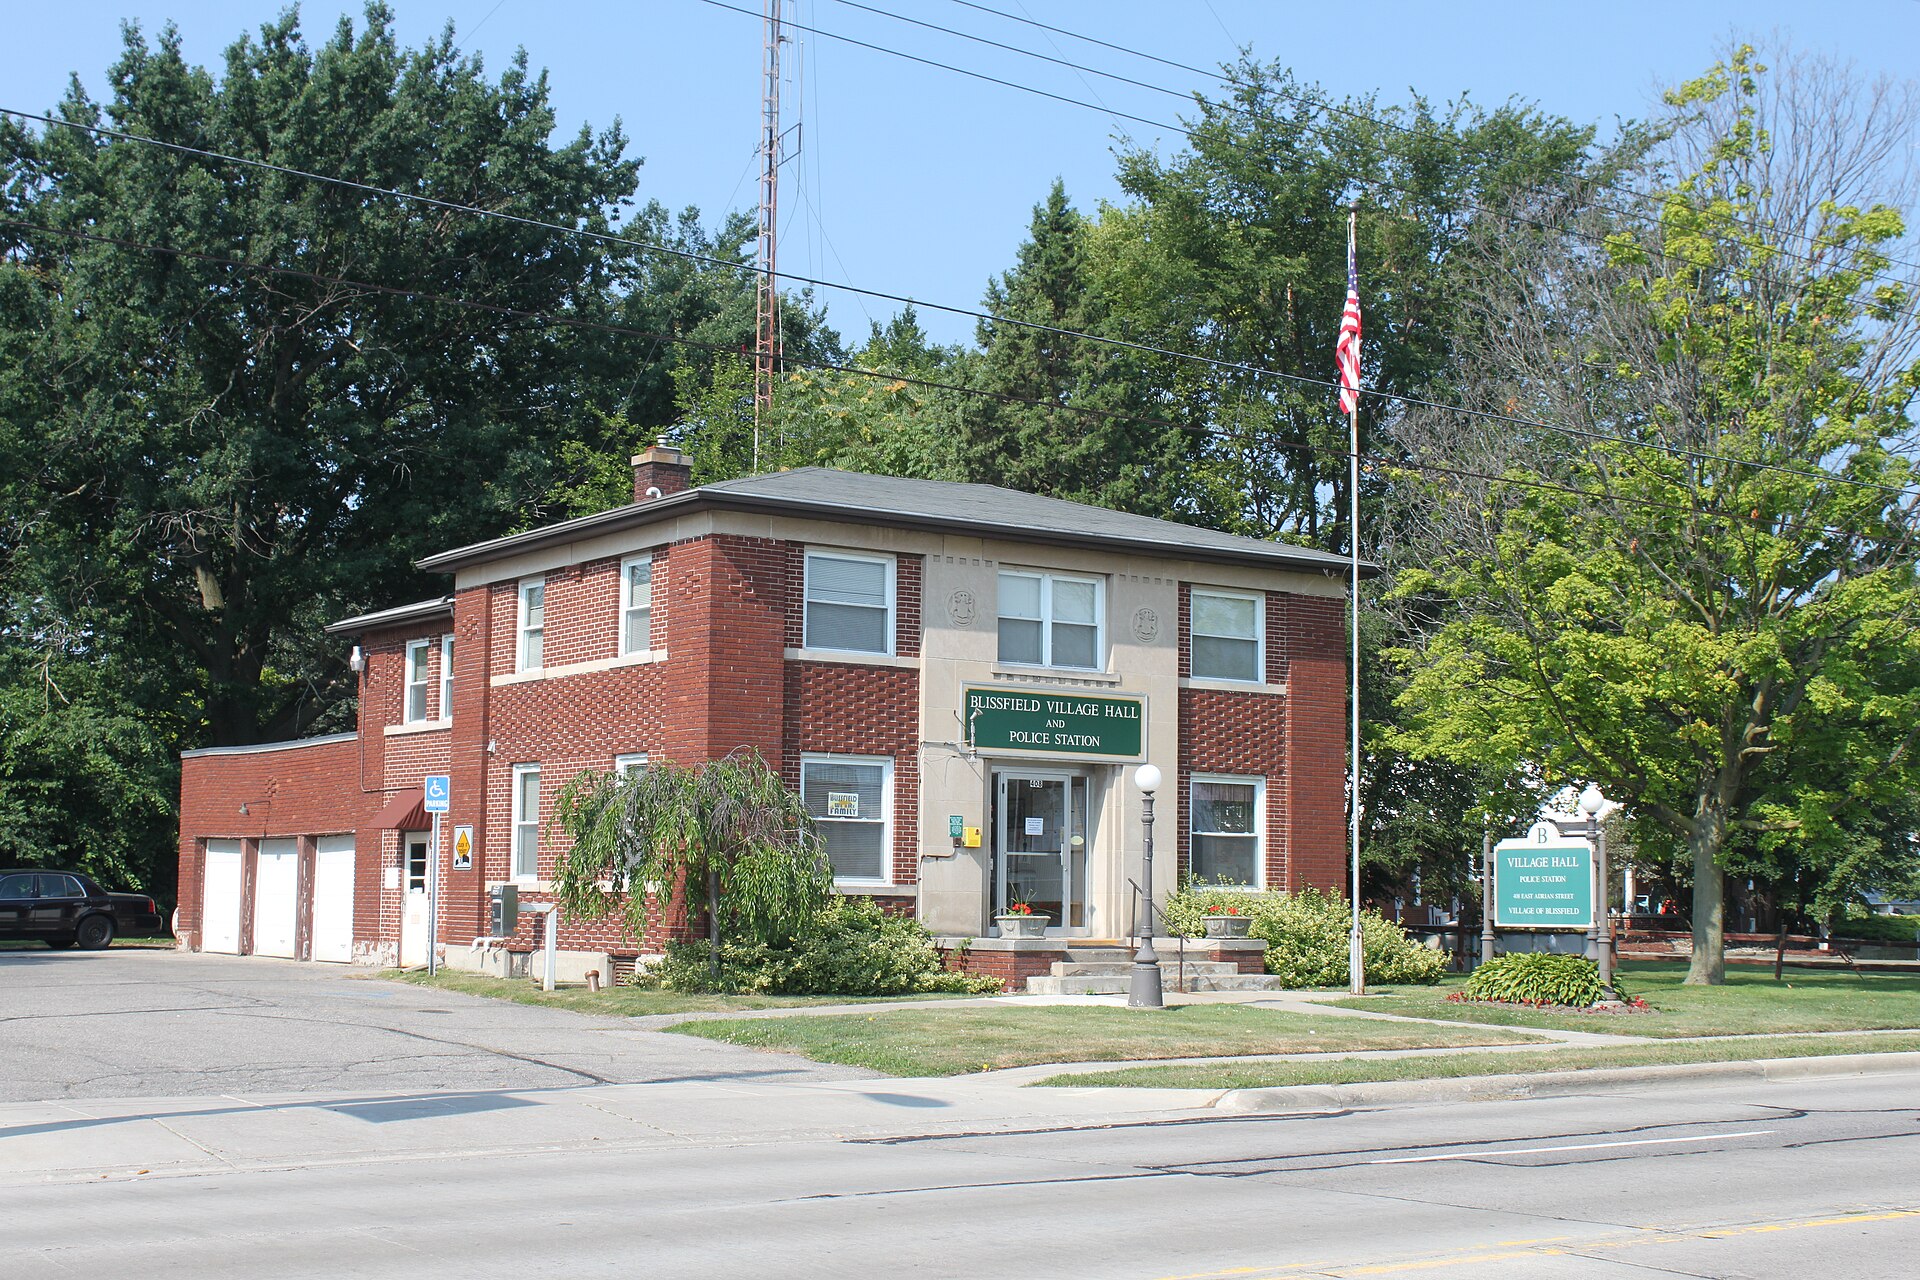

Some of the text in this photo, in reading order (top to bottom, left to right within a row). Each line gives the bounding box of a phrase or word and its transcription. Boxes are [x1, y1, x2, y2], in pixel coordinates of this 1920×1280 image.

[970, 695, 1139, 719] BLISSFIELD VILLAGE HALL
[1045, 719, 1065, 729] AND
[1009, 731, 1100, 747] POLICE STATION
[426, 799, 448, 807] PARKING
[1537, 827, 1548, 844] B
[1507, 856, 1579, 868] VILLAGE HALL
[1519, 875, 1567, 883] POLICE STATION
[1508, 907, 1580, 915] VILLAGE OF BLISSFIELD
